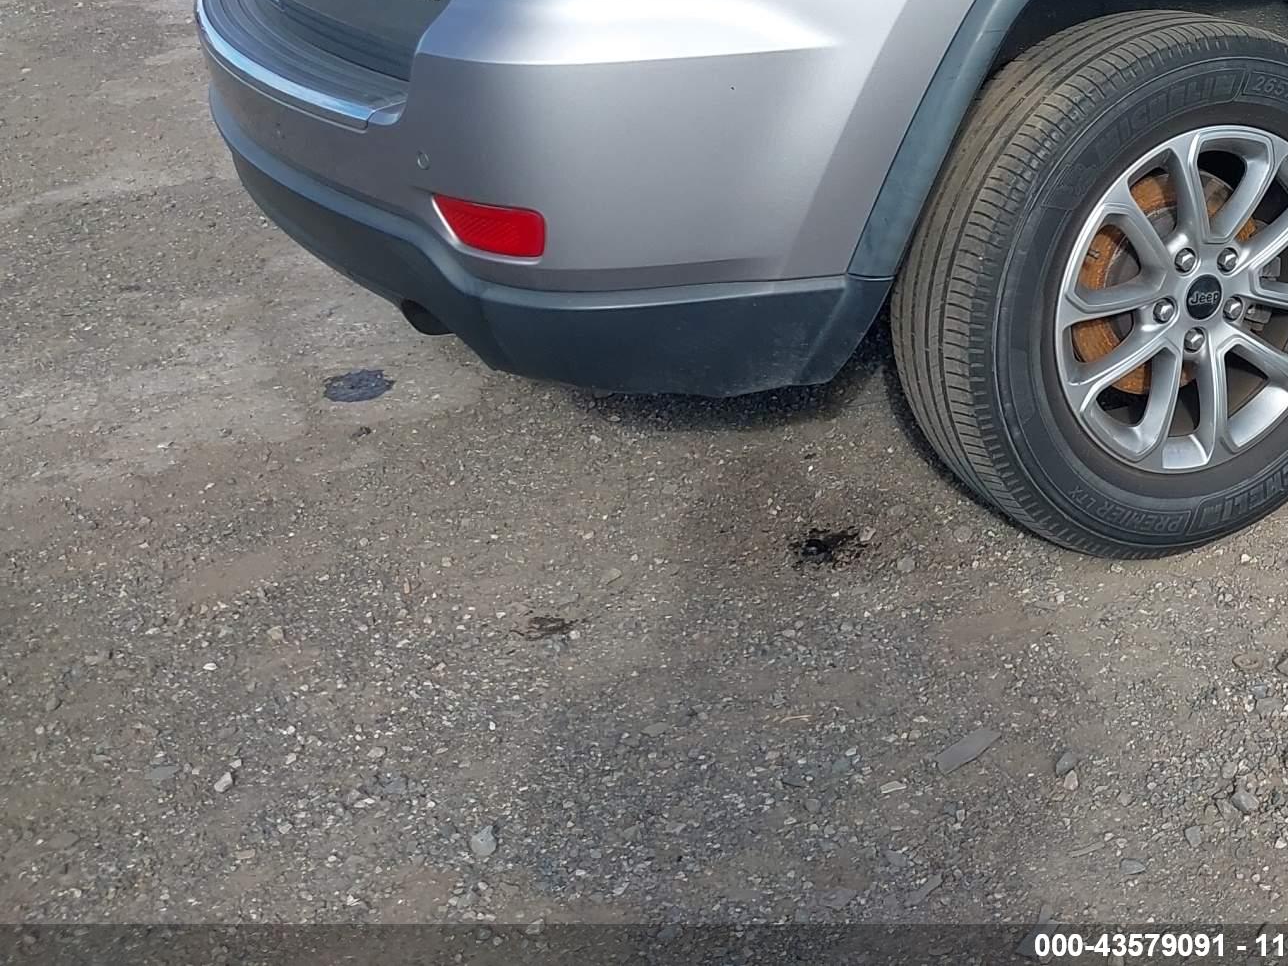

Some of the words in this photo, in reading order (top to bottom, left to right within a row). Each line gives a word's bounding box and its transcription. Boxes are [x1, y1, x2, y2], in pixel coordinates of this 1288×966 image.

[1189, 291, 1220, 305] Jeep
[1068, 484, 1097, 510] LTX
[1095, 500, 1184, 532] PREMIER
